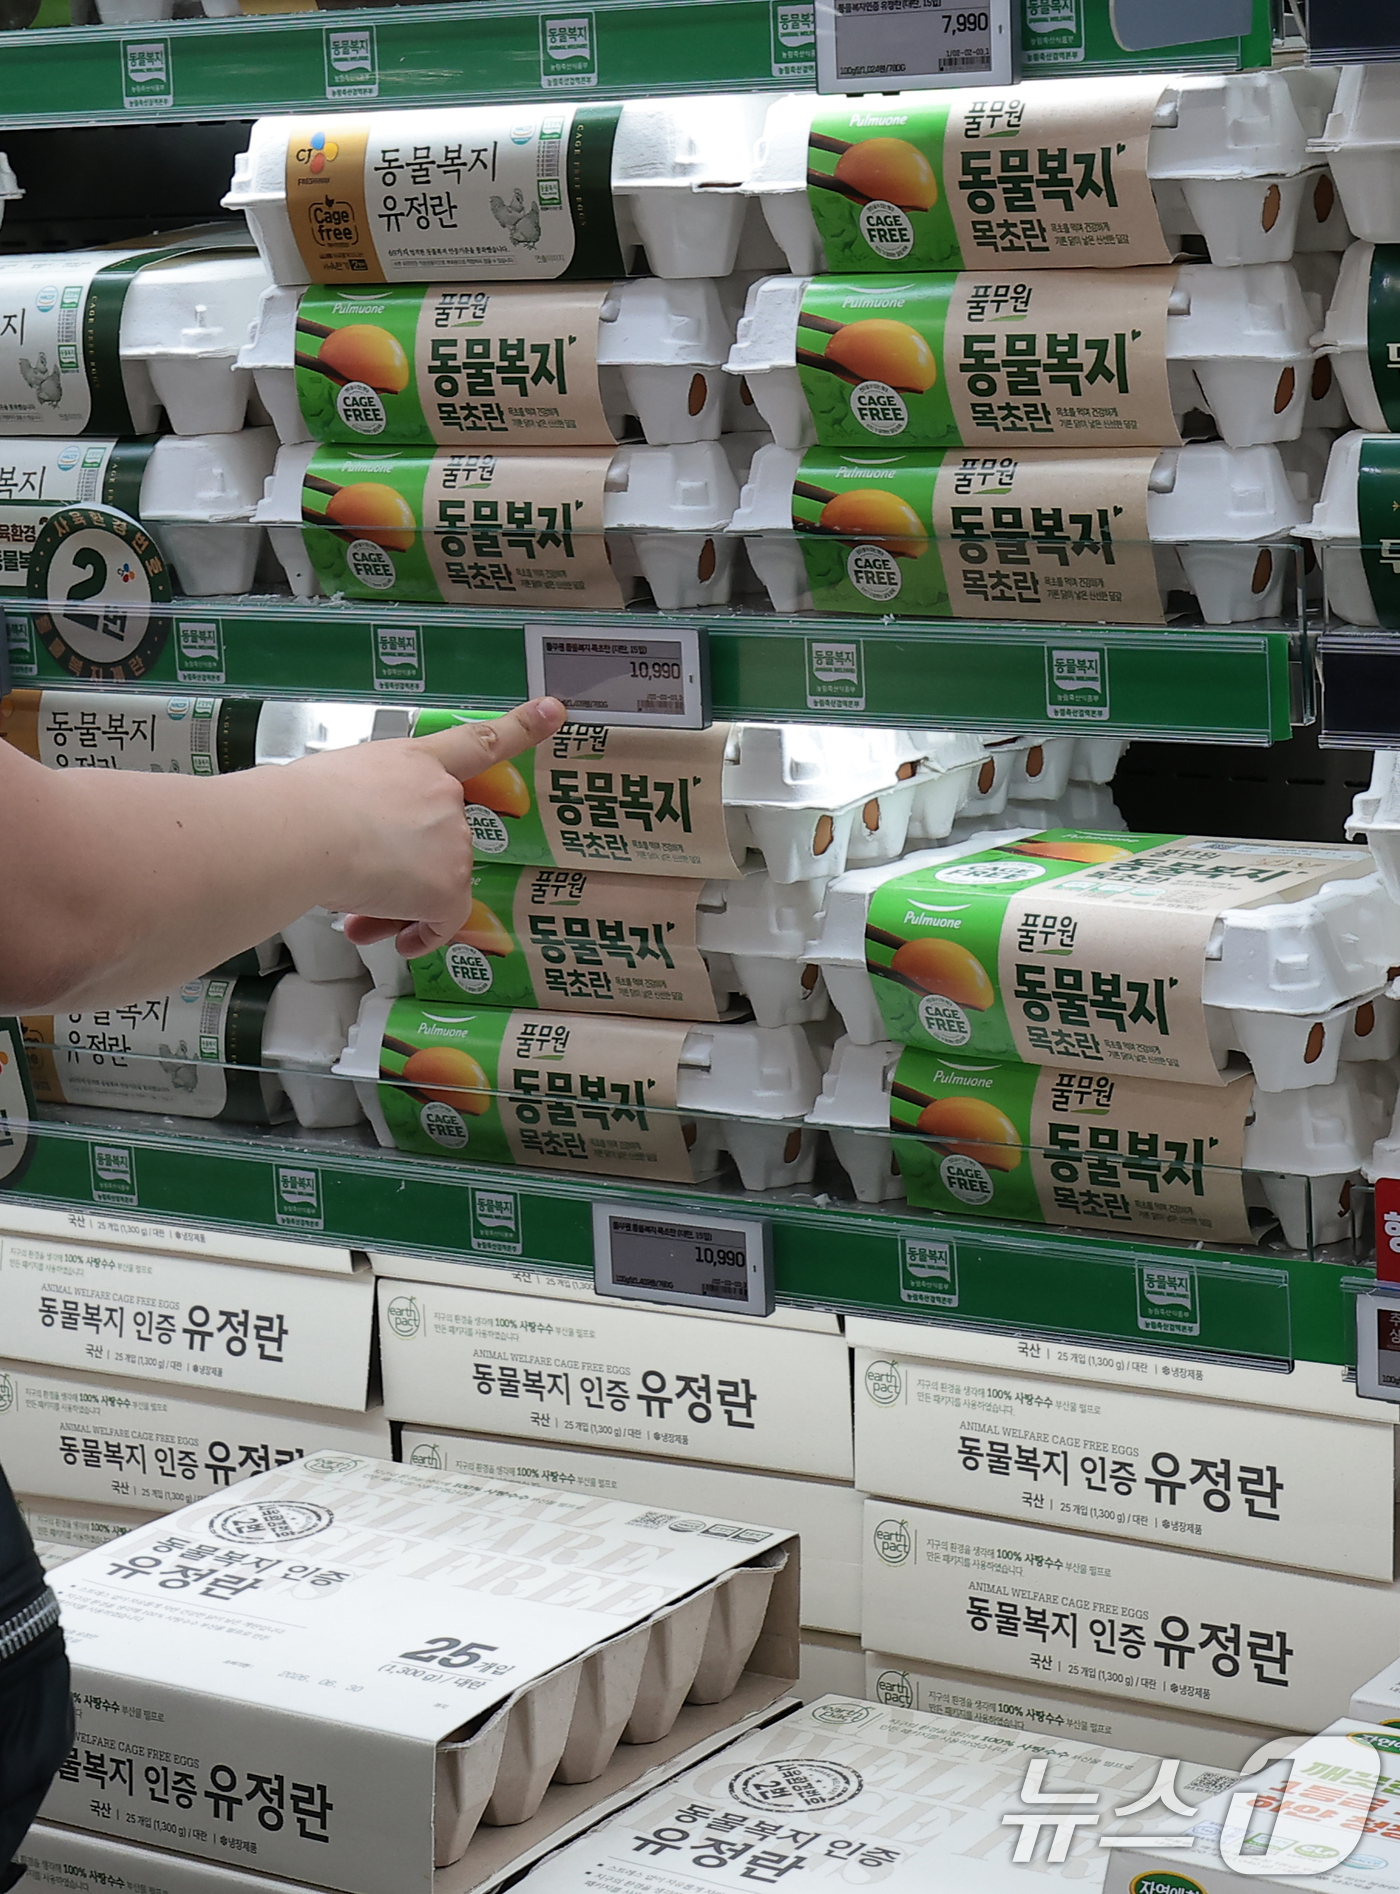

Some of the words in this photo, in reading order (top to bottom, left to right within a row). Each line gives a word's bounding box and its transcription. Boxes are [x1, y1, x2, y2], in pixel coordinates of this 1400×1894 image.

[548, 26, 588, 43] 동물복지
[942, 12, 988, 35] 7,990
[129, 51, 164, 66] 동물복지
[331, 39, 368, 56] 동물복지
[849, 113, 908, 127] Pulmuone
[964, 100, 1026, 138] 풀무원
[373, 141, 498, 187] 동물복지
[958, 147, 1118, 214] 동물복지
[314, 208, 349, 225] Cage
[378, 191, 458, 232] 유정란
[866, 215, 902, 228] CAGE
[318, 225, 352, 241] free
[867, 225, 910, 243] FREE
[971, 219, 1050, 253] 목초란
[332, 302, 385, 315] Pulmuone
[435, 292, 490, 328] 풀무원
[841, 296, 905, 309] Pulmuone
[967, 284, 1032, 322] 풀무원
[428, 337, 567, 397] 동물복지
[959, 332, 1129, 397] 동물복지
[343, 396, 375, 407] CAGE
[857, 395, 897, 406] CAGE
[343, 407, 383, 422] FREE
[437, 403, 508, 432] 목초란
[858, 407, 904, 422] FREE
[970, 403, 1054, 433] 목초란
[442, 454, 497, 489] 풀무원
[836, 465, 896, 479] Pulmuone
[954, 457, 1018, 495] 풀무원
[434, 500, 575, 560] 동물복지
[950, 506, 1116, 567] 동물복지
[352, 551, 386, 564] CAGE
[854, 558, 891, 571] CAGE
[353, 563, 394, 577] FREE
[445, 562, 517, 592] 목초란
[854, 570, 898, 586] FREE
[962, 570, 1042, 603] 목초란
[181, 626, 216, 646] 동물복지
[379, 637, 416, 651] 동물복지
[630, 661, 680, 680] 10,990
[814, 651, 855, 667] 동물복지
[1054, 657, 1098, 674] 동물복지
[46, 711, 157, 752] 동물복지
[553, 724, 609, 759] 풀무원
[549, 769, 692, 833] 동물복지
[560, 830, 632, 862] 목초란
[531, 870, 588, 905] 풀무원
[903, 910, 962, 930] Pulmuone
[528, 914, 675, 970] 동물복지
[1016, 913, 1079, 954] 풀무원
[451, 954, 484, 967] CAGE
[452, 966, 490, 981] FREE
[544, 968, 615, 1000] 목초란
[1014, 963, 1169, 1036] 동물복지
[924, 1006, 961, 1021] CAGE
[417, 1022, 469, 1039] Pulmuone
[925, 1018, 968, 1035] FREE
[67, 1030, 131, 1068] 유정란
[516, 1023, 570, 1060] 풀무원
[1027, 1025, 1104, 1061] 목초란
[932, 1069, 993, 1088] Pulmuone
[508, 1068, 650, 1132] 동물복지
[1051, 1072, 1115, 1112] 풀무원
[426, 1113, 459, 1126] CAGE
[427, 1124, 464, 1139] FREE
[519, 1128, 588, 1160] 목초란
[96, 1152, 129, 1169] 동물복지
[1043, 1121, 1205, 1197] 동물복지
[280, 1175, 314, 1191] 동물복지
[946, 1164, 984, 1180] CAGE
[947, 1177, 990, 1194] FREE
[476, 1198, 513, 1215] 동물복지
[1053, 1186, 1132, 1221] 목초란
[695, 1246, 745, 1268] 10,990
[907, 1247, 948, 1263] 동물복지
[1145, 1273, 1189, 1292] 동물복지
[389, 1307, 416, 1317] earth
[395, 1316, 419, 1327] pact
[39, 1296, 124, 1339] 동물복지
[133, 1310, 176, 1345] 인증
[182, 1304, 289, 1363] 유정란
[494, 1317, 518, 1329] 100%
[519, 1320, 554, 1335] 사탕수수
[473, 1349, 509, 1361] ANIMAL
[510, 1353, 552, 1367] WELFARE
[553, 1359, 580, 1370] CAGE
[581, 1362, 605, 1372] FREE
[606, 1365, 631, 1376] EGGS
[1018, 1342, 1041, 1359] 국산
[1057, 1351, 1069, 1361] 25
[867, 1364, 897, 1383] earth
[472, 1364, 571, 1406] 동물복지
[580, 1376, 630, 1413] 인증
[636, 1369, 758, 1430] 유정란
[873, 1381, 899, 1395] pact
[987, 1387, 1012, 1401] 100%
[1014, 1392, 1053, 1409] 사탕수수
[530, 1412, 550, 1427] 국산
[960, 1420, 1000, 1435] ANIMAL
[1002, 1429, 1049, 1444] WELFARE
[1051, 1434, 1081, 1449] CAGE
[1083, 1439, 1109, 1452] FREE
[1111, 1444, 1139, 1458] EGGS
[59, 1436, 147, 1475] 동물복지
[154, 1447, 199, 1481] 인증
[957, 1436, 1069, 1486] 동물복지
[1080, 1456, 1137, 1497] 인증
[1144, 1450, 1284, 1522] 유정란
[1021, 1491, 1044, 1509] 국산
[1060, 1503, 1071, 1512] 25
[1073, 1504, 1088, 1517] 개입
[152, 1536, 283, 1574] 동물복지
[281, 1564, 352, 1587] 인증
[996, 1548, 1022, 1562] 100%
[1024, 1553, 1064, 1570] 사탕수수
[106, 1555, 264, 1600] 유정란
[968, 1581, 1009, 1596] ANIMAL
[1011, 1587, 1059, 1605] WELFARE
[1061, 1596, 1091, 1610] CAGE
[1092, 1601, 1119, 1615] FREE
[1120, 1606, 1149, 1621] EGGS
[965, 1595, 1078, 1649] 동물복지
[1089, 1618, 1147, 1660] 인증
[1153, 1615, 1294, 1688] 유정란
[1029, 1653, 1053, 1671] 국산
[1068, 1664, 1079, 1675] 25
[377, 1662, 426, 1680] (1,300
[452, 1677, 488, 1691] 대란
[118, 1742, 145, 1757] CAGE
[147, 1748, 172, 1763] FREE
[173, 1755, 200, 1769] EGGS
[90, 1799, 111, 1820] 국산
[126, 1812, 136, 1824] 25
[144, 1765, 197, 1810] 인증
[204, 1764, 333, 1844] 유정란
[674, 1802, 822, 1851] 동물복지
[825, 1837, 903, 1869] 인증
[632, 1826, 806, 1884] 유정란
[62, 1863, 87, 1879] 100%
[89, 1868, 125, 1890] 사탕수수
